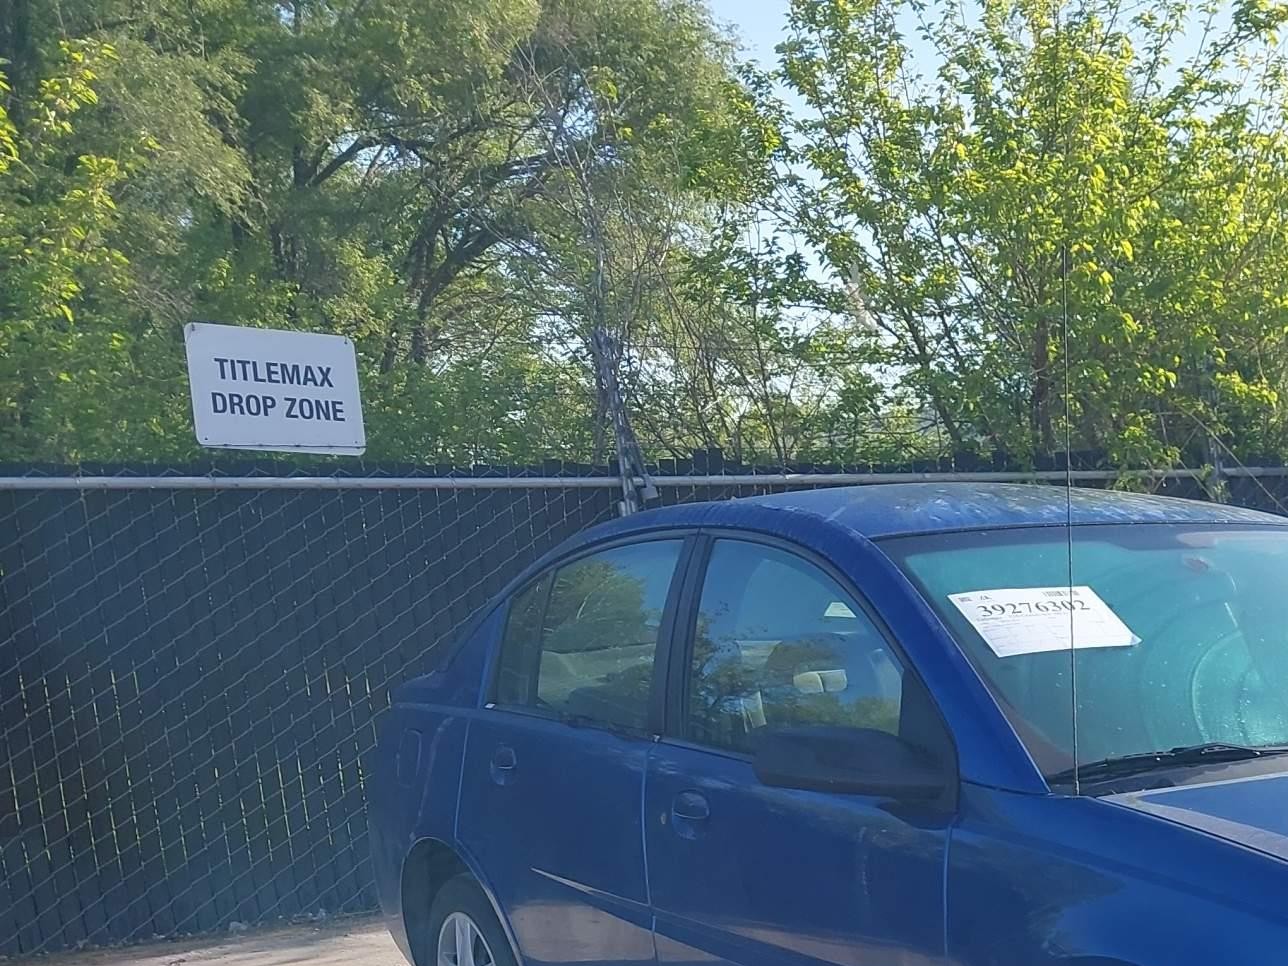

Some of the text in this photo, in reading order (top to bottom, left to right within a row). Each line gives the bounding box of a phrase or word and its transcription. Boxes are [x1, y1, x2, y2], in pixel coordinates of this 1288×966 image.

[214, 358, 334, 388] TITLEMAX
[211, 392, 346, 422] DROP ZONE
[977, 600, 1091, 617] 39276302
